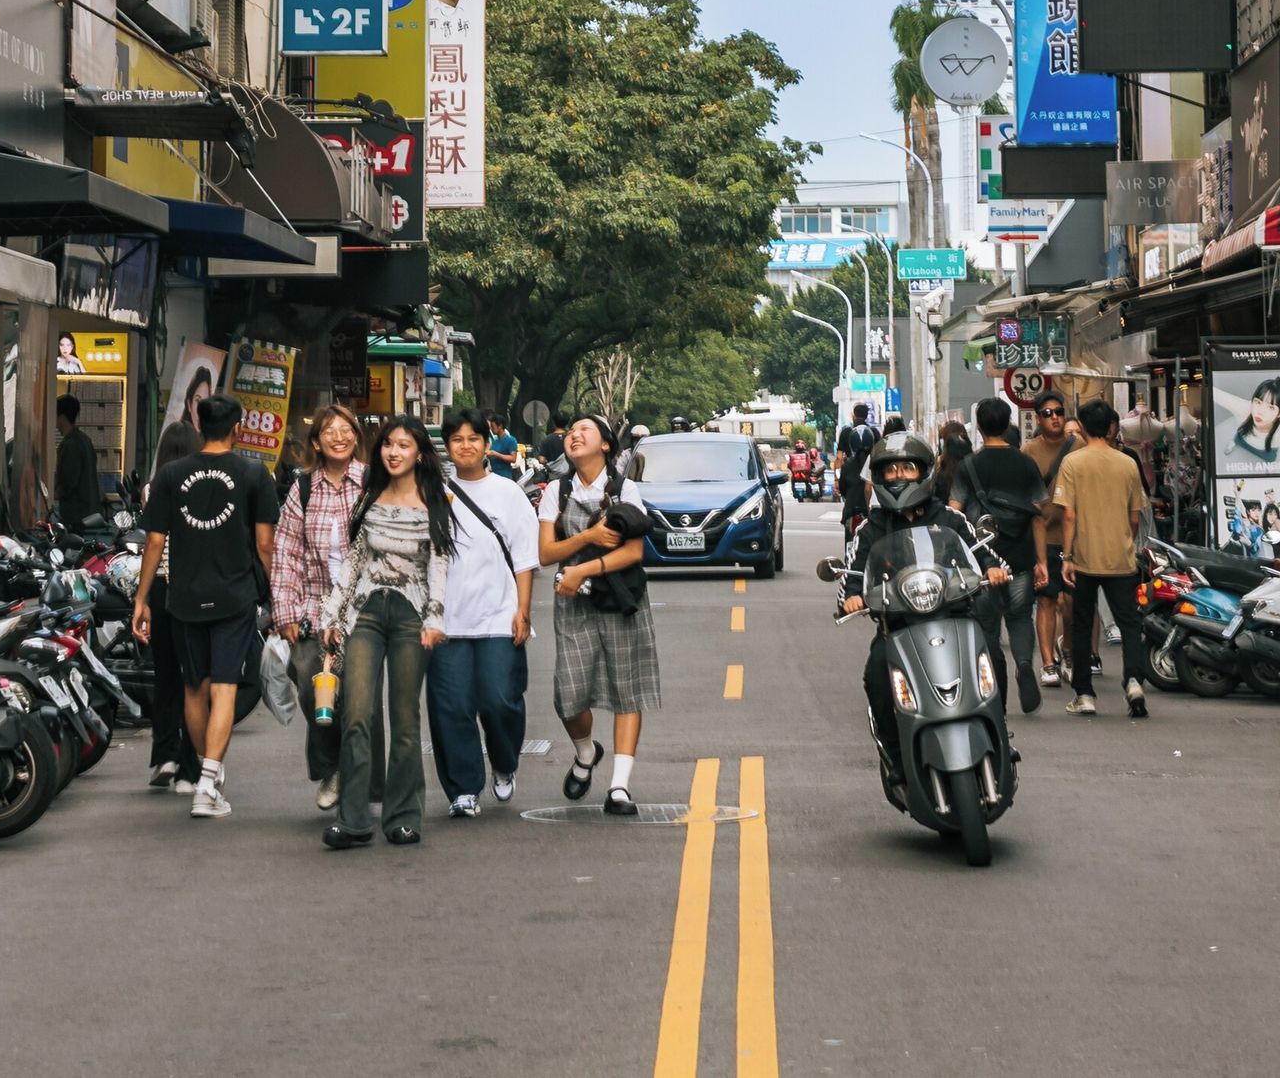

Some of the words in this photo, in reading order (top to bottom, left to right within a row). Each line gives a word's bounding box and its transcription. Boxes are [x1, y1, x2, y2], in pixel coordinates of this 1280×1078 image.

[331, 8, 371, 35] 2F
[101, 91, 133, 102] SHOP
[426, 43, 468, 175] 鳳梨酥
[1115, 176, 1143, 191] AIR
[989, 206, 1046, 219] FamilyMart
[906, 267, 942, 277] Yizhong
[946, 267, 956, 275] St
[1013, 373, 1043, 392] 30
